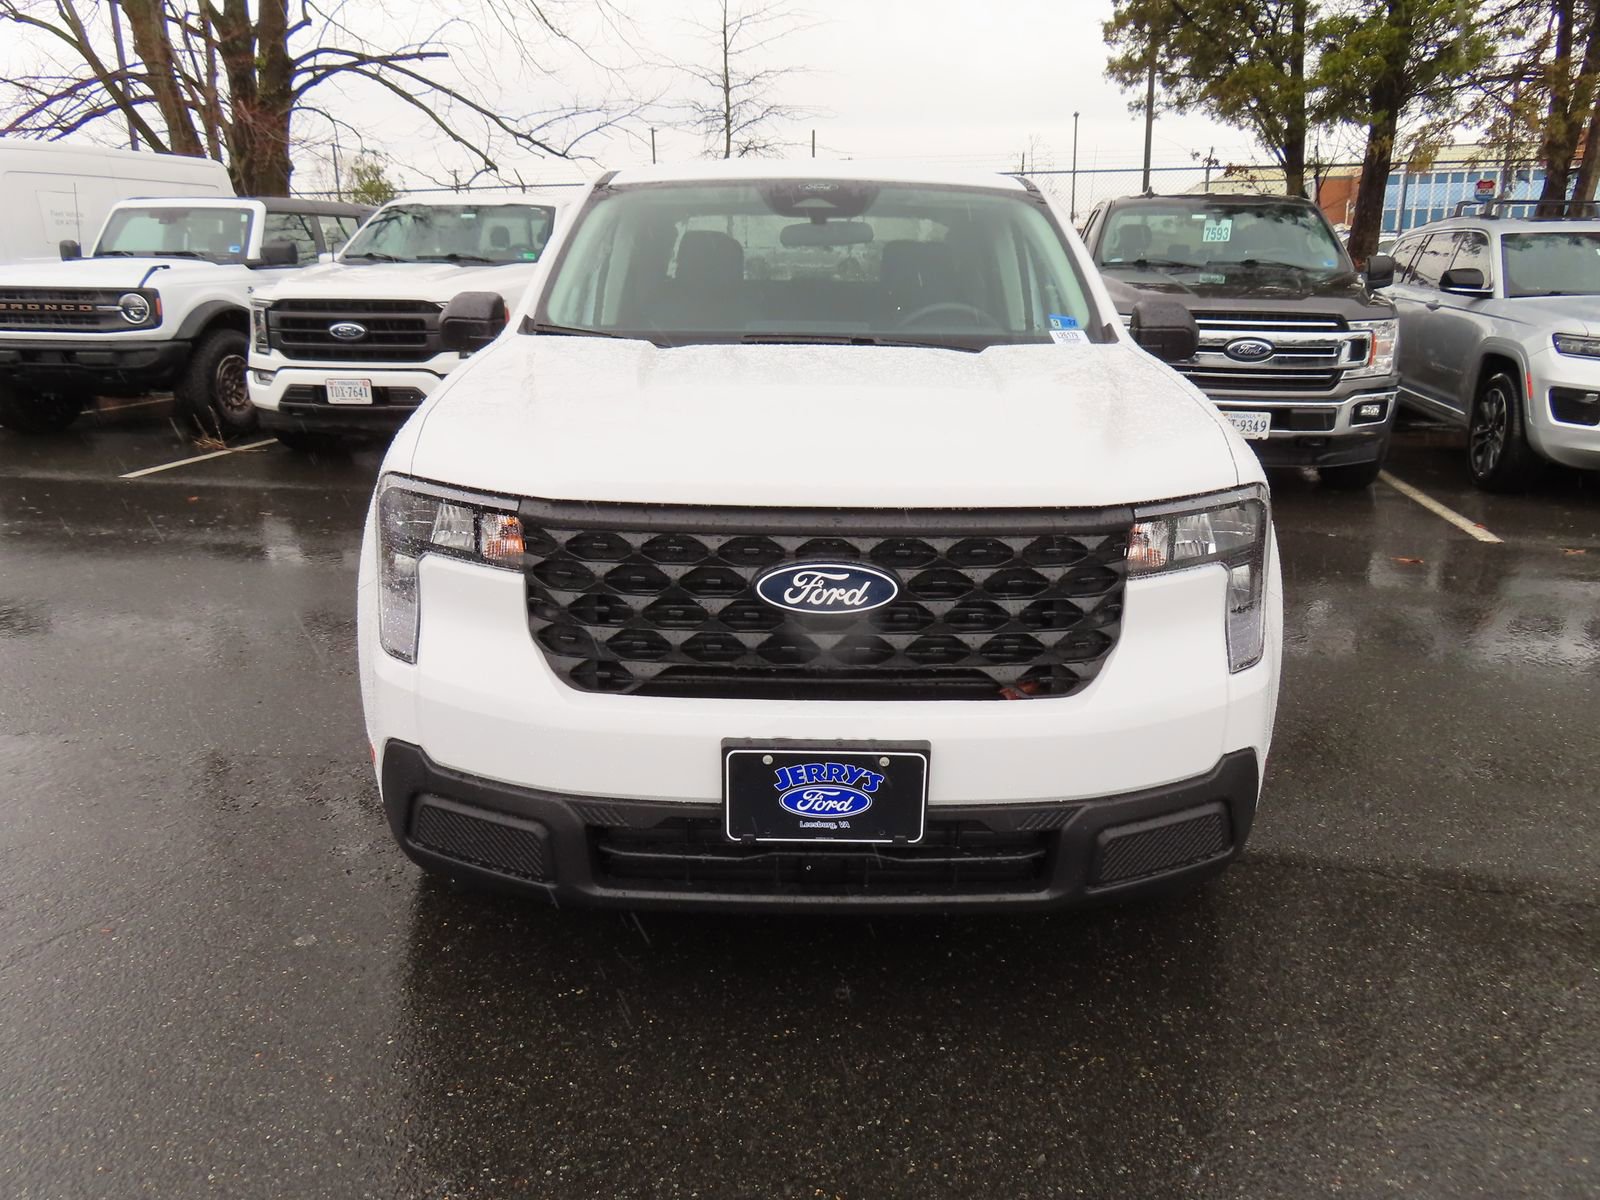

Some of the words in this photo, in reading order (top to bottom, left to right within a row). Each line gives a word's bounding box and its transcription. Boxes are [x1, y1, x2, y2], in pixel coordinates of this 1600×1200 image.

[1205, 227, 1229, 241] 7593
[1237, 343, 1262, 355] Ford
[329, 386, 368, 398] TDX-7641
[1227, 419, 1267, 432] T-9349
[783, 570, 872, 606] Ford
[773, 762, 885, 793] JERRY'S
[796, 788, 853, 813] Ford
[799, 820, 838, 830] Leesburg,
[838, 820, 851, 829] VA
